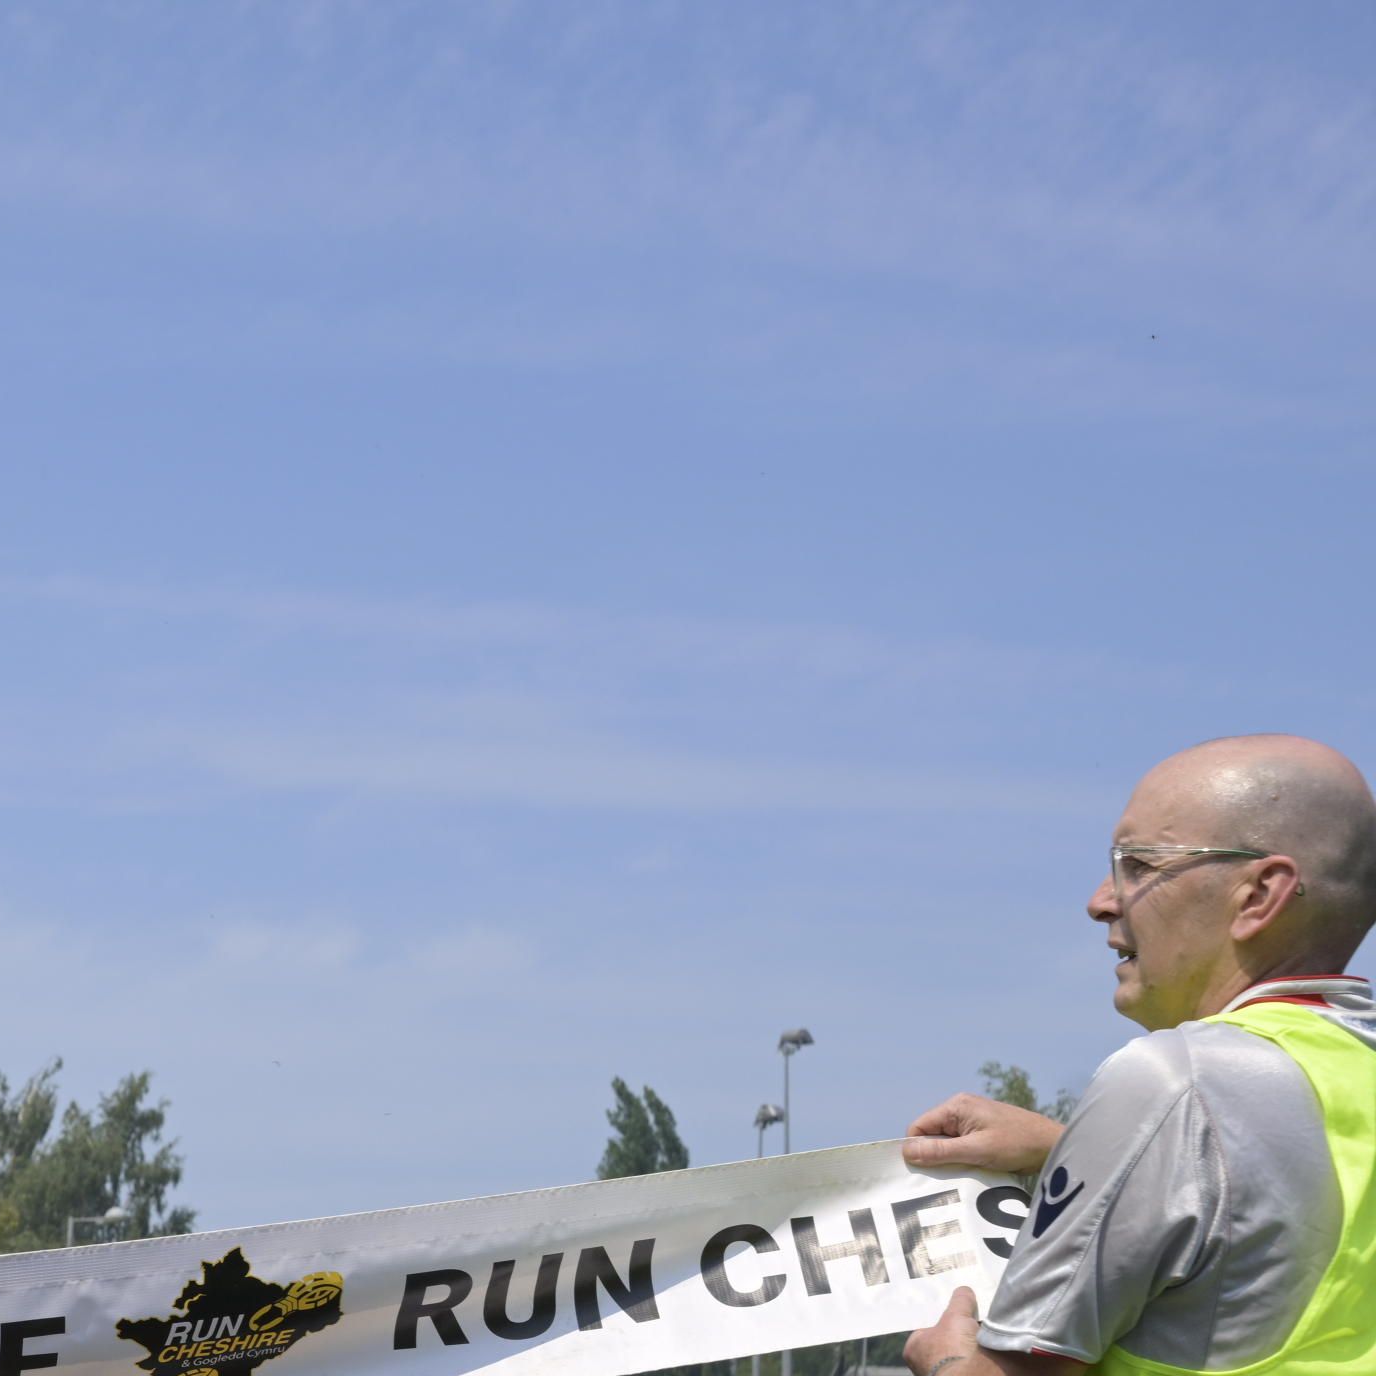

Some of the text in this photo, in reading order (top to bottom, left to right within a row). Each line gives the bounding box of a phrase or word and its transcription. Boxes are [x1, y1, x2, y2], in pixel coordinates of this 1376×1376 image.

[393, 1185, 1032, 1351] RUN CHES
[158, 1328, 296, 1363] CHESHIRE
[164, 1314, 244, 1346] RUN
[181, 1345, 285, 1368] & Gogledd Cymru
